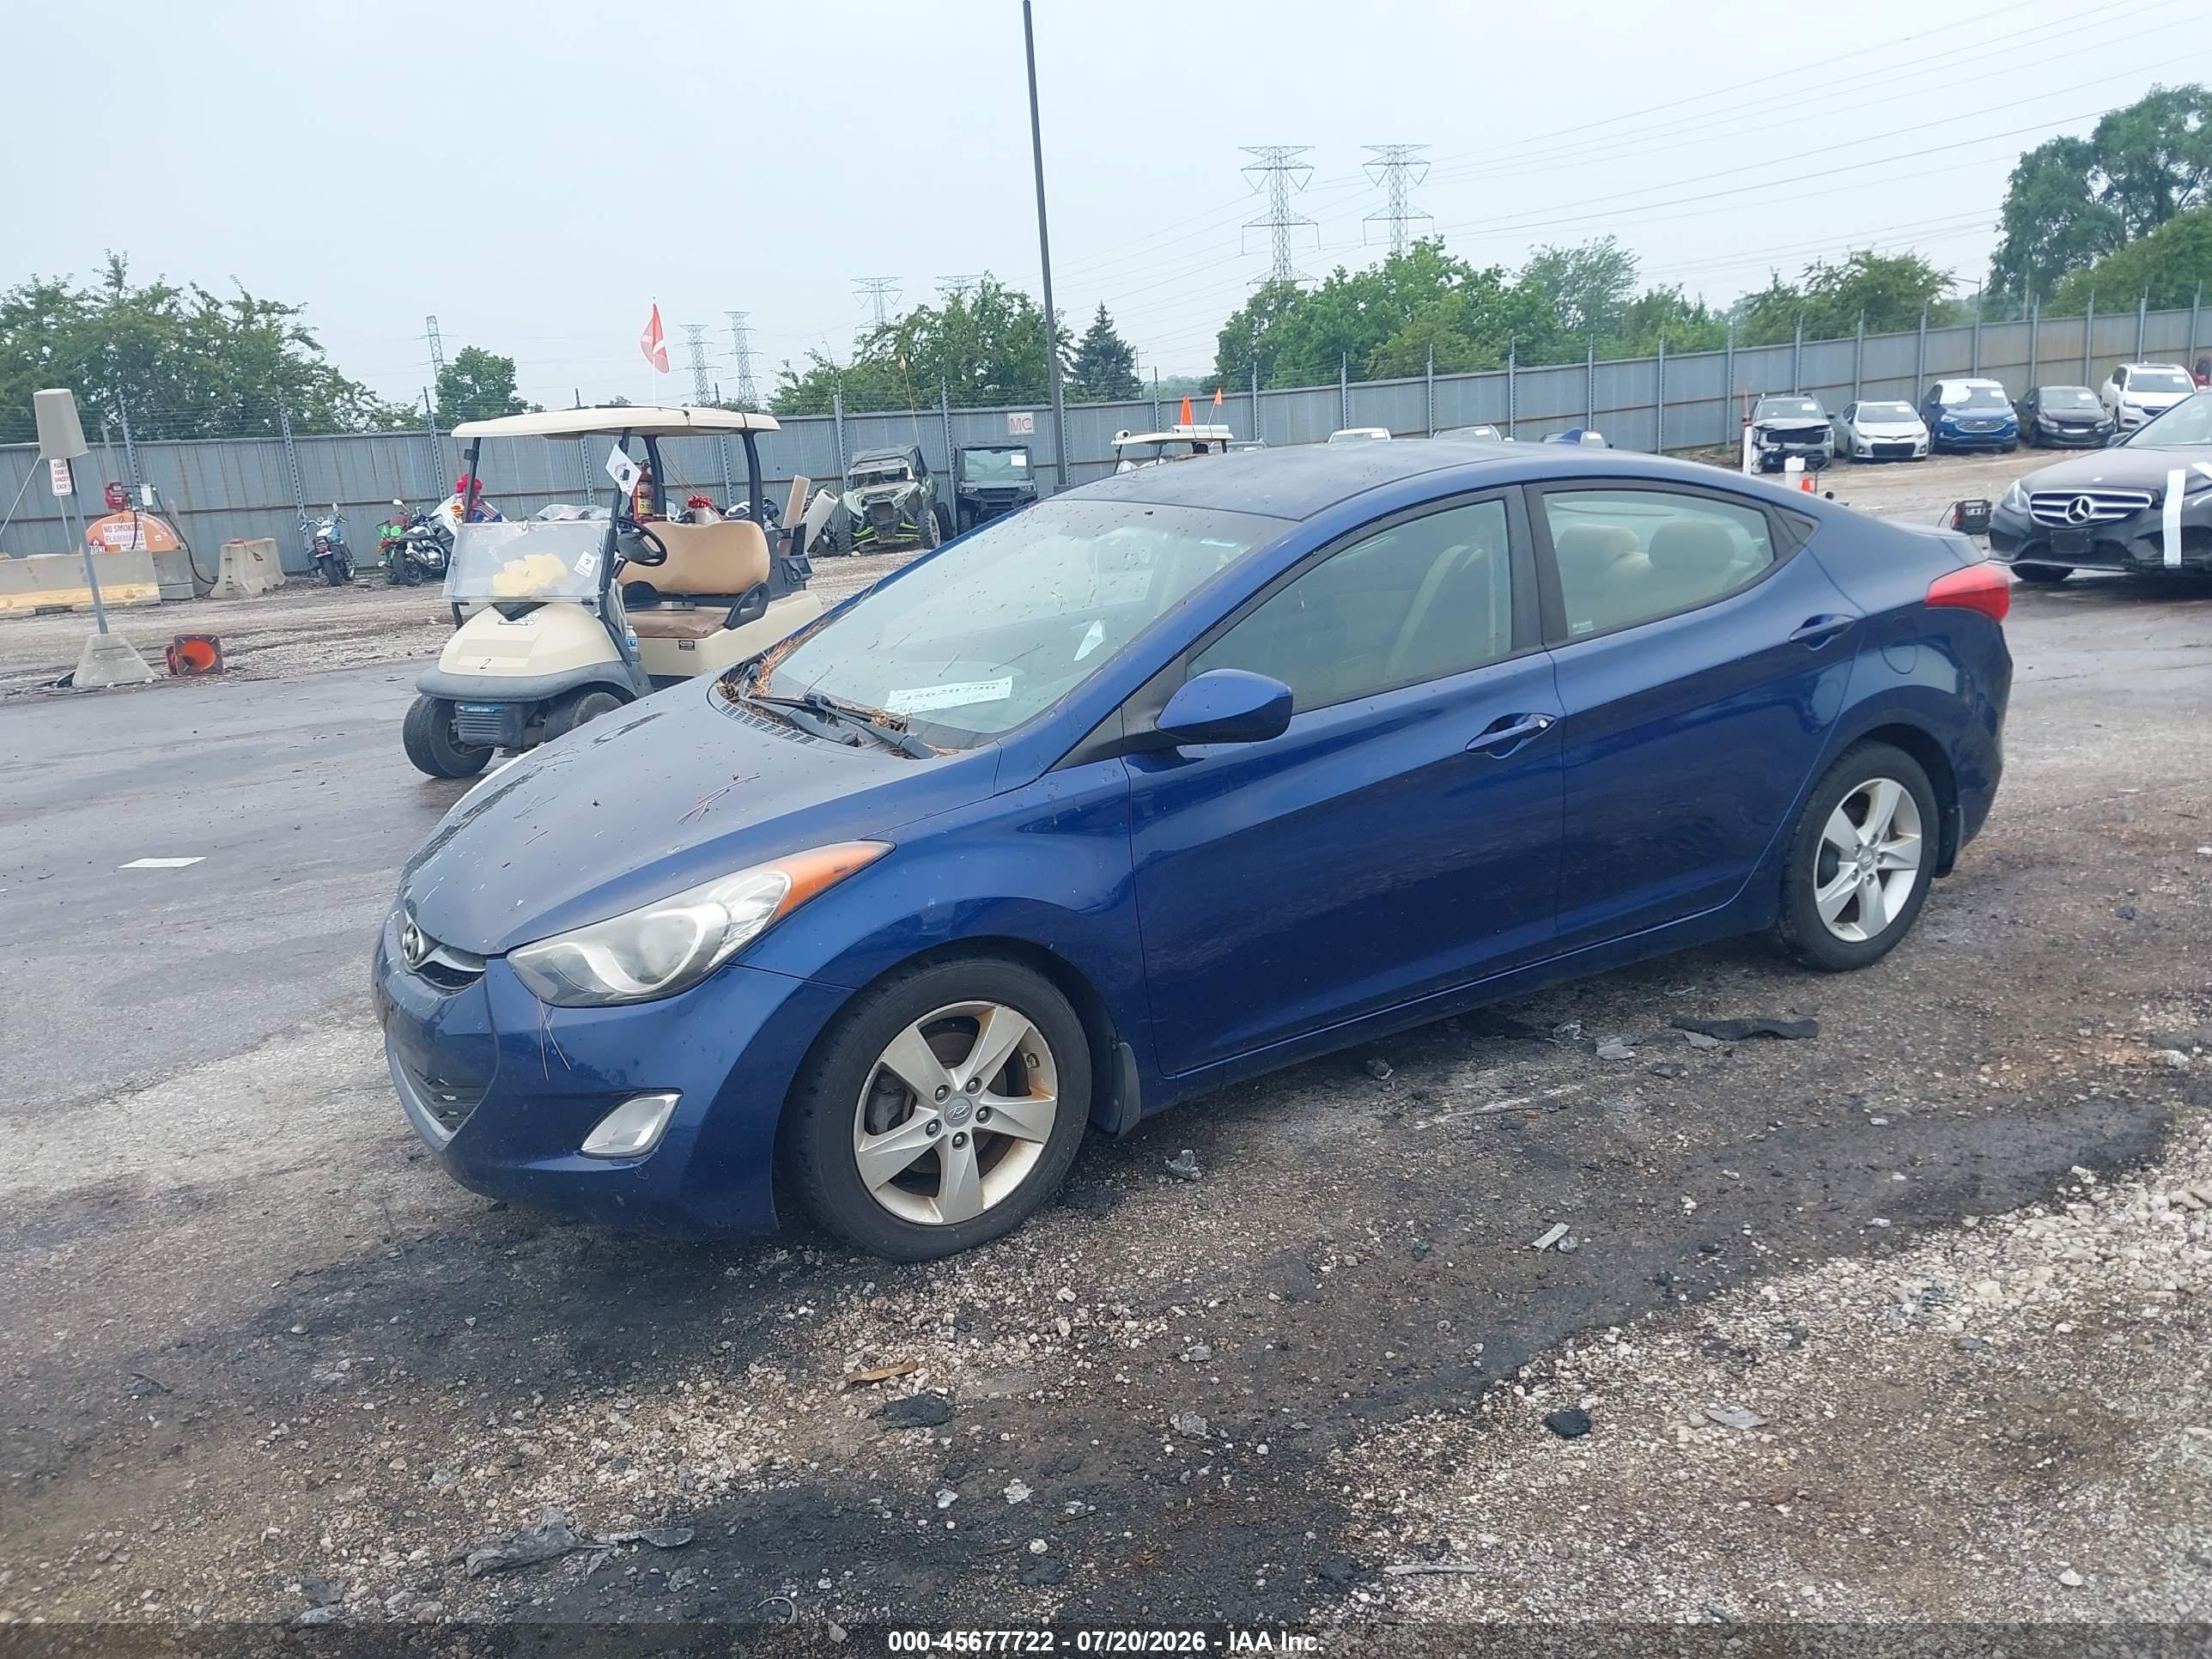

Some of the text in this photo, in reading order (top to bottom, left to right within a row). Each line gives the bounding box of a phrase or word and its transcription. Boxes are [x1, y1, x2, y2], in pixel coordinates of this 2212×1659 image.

[1010, 417, 1033, 432] MC
[113, 524, 143, 532] SMOKIG
[106, 533, 144, 543] FLAMMALE
